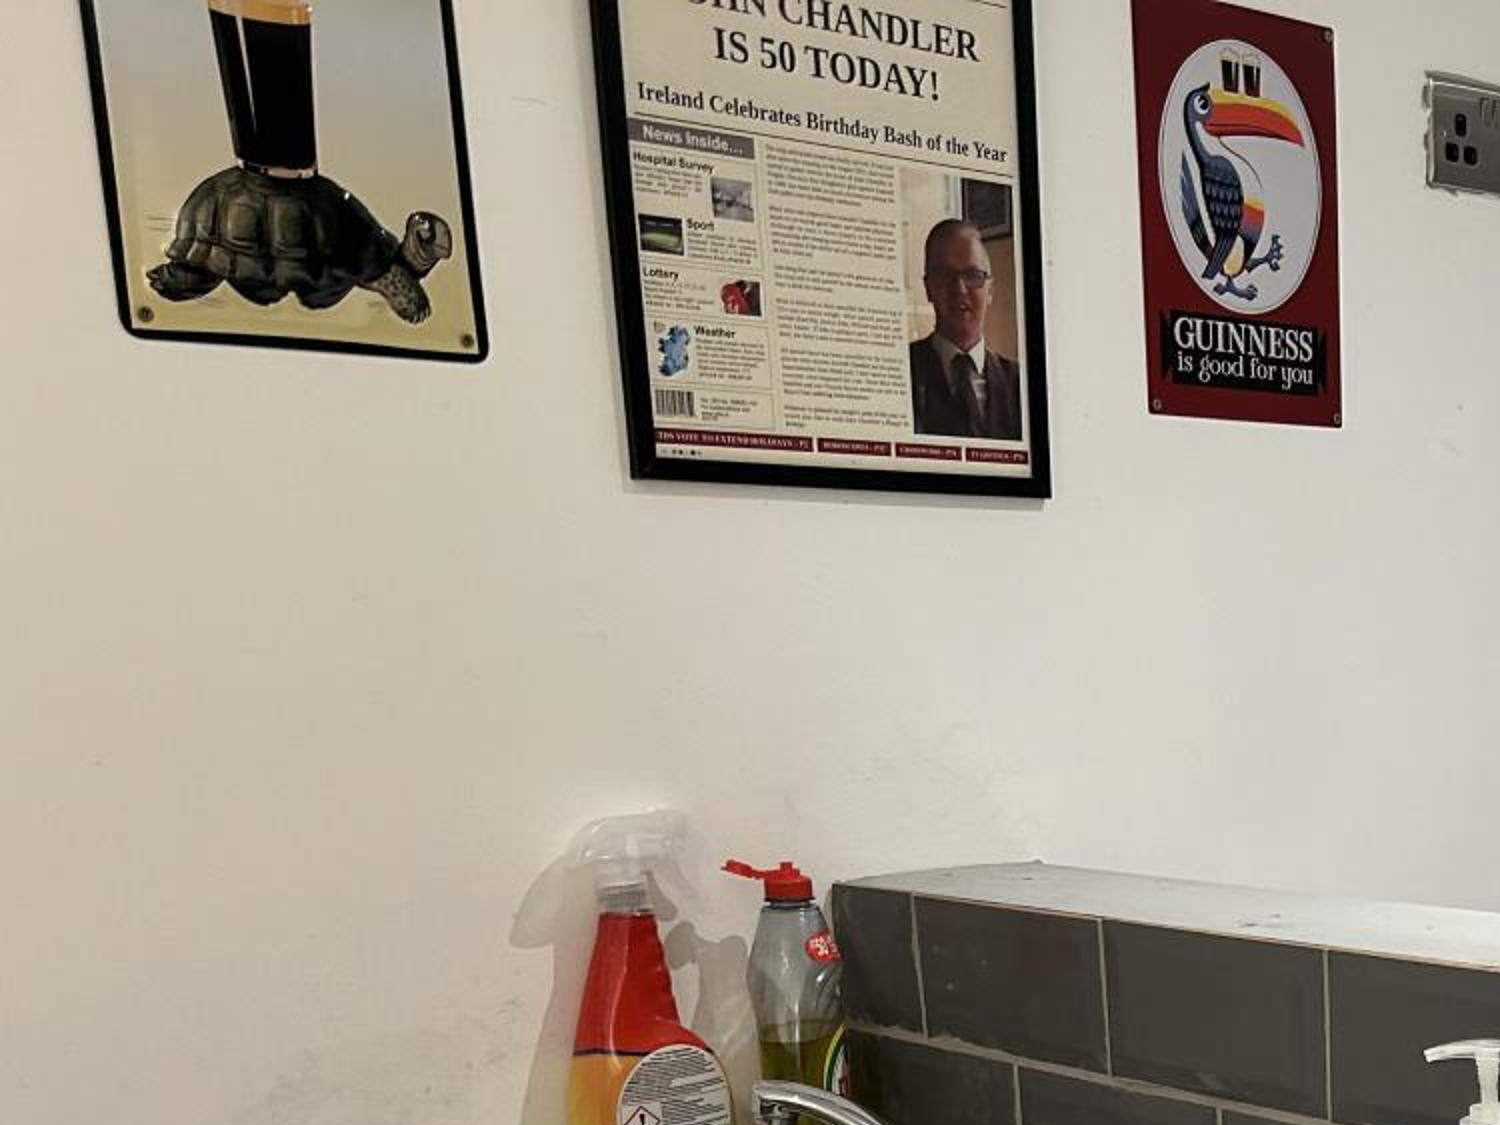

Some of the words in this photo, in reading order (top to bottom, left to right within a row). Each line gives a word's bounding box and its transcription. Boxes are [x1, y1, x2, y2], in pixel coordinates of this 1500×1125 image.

[778, 0, 980, 62] CHANDLER
[714, 27, 749, 64] IS
[760, 36, 796, 73] 50
[803, 45, 939, 101] TODAY!
[638, 82, 704, 111] Ireland
[709, 94, 801, 126] Celebrates
[806, 111, 879, 144] Birthday
[884, 125, 922, 149] Bash
[927, 134, 941, 152] of
[946, 138, 969, 157] the
[973, 141, 1008, 163] Year
[643, 125, 682, 144] News
[633, 151, 676, 167] Hospital
[678, 157, 714, 174] Survey
[686, 218, 714, 231] Sport
[642, 266, 679, 281] Lottery
[694, 325, 736, 339] Weather
[1173, 316, 1314, 364] GUINNESS
[1177, 351, 1193, 372] is
[1198, 354, 1245, 383] good
[1250, 357, 1277, 381] for
[1282, 366, 1314, 390] you
